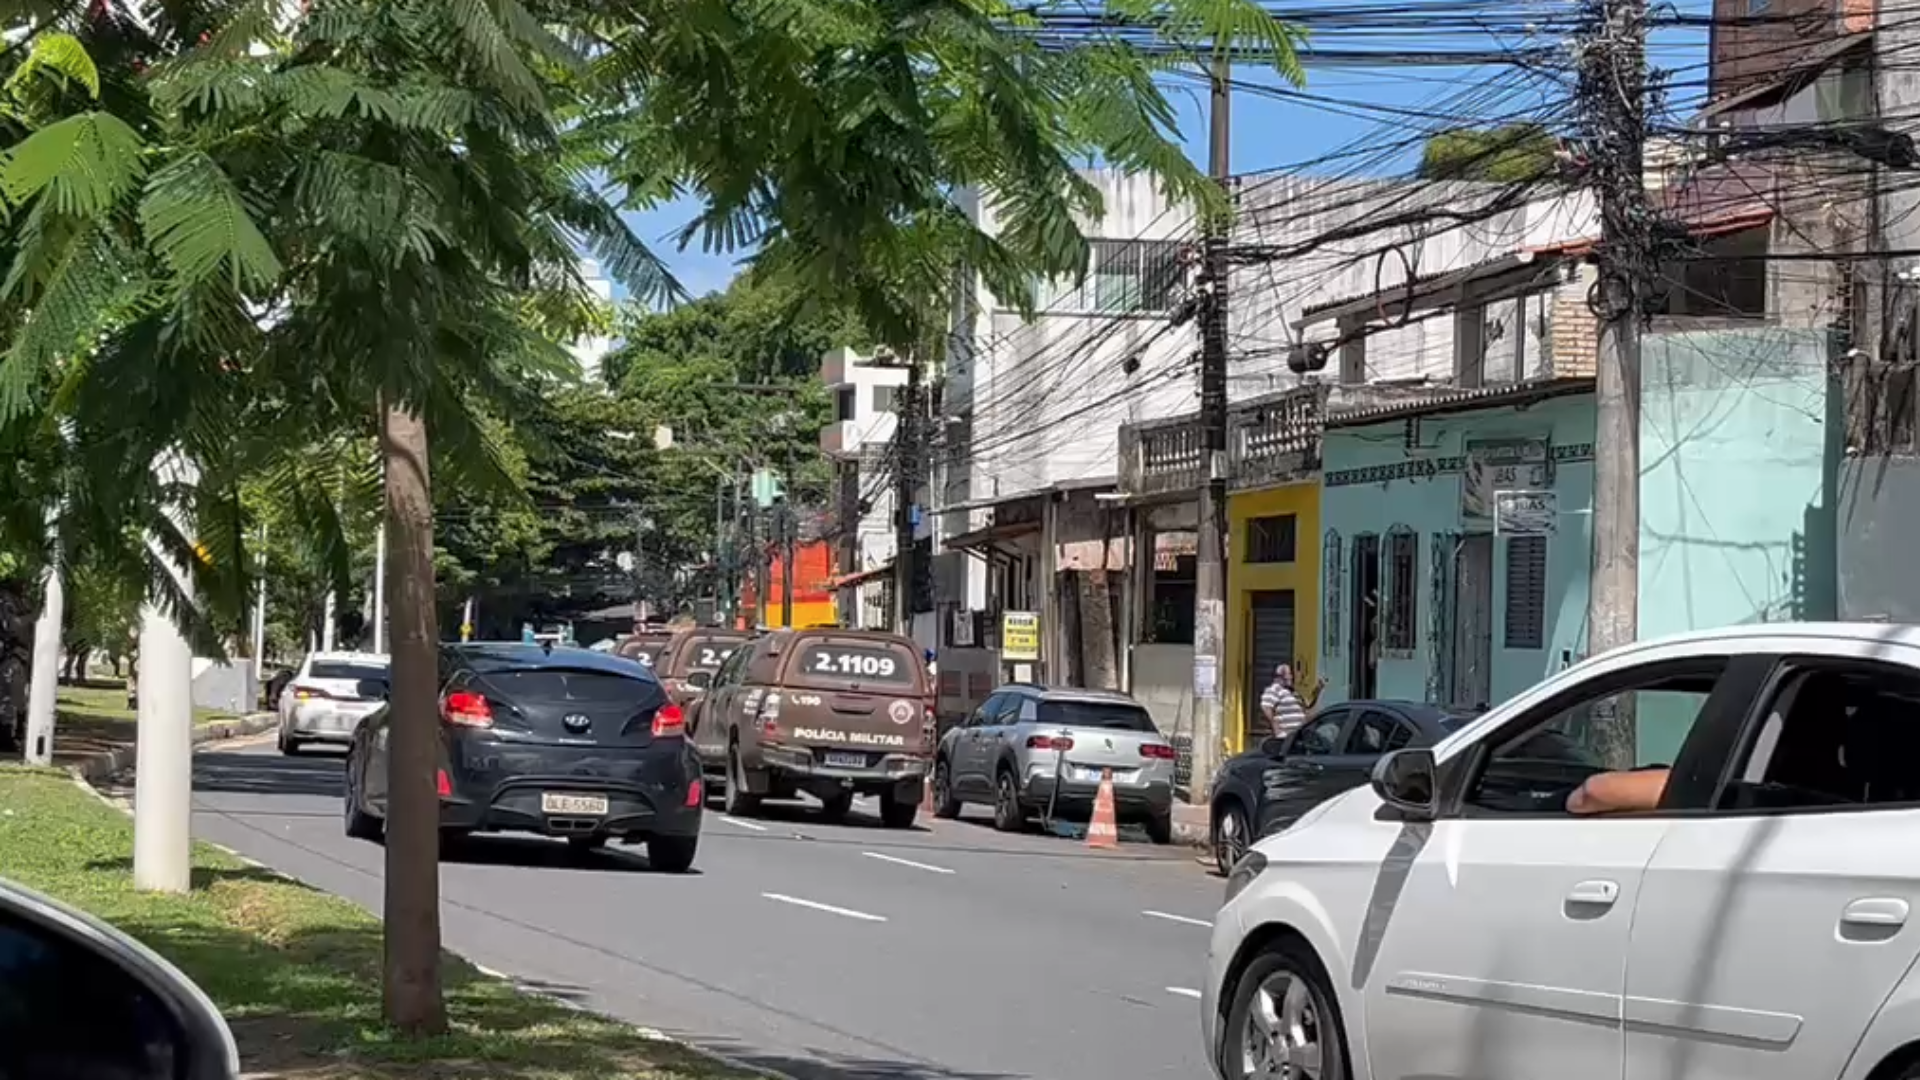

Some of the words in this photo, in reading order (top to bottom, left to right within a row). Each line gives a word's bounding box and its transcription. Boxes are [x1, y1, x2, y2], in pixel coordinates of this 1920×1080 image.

[816, 652, 896, 676] 2.1109
[794, 727, 847, 741] POLÍCIA
[849, 732, 904, 745] MILITAR
